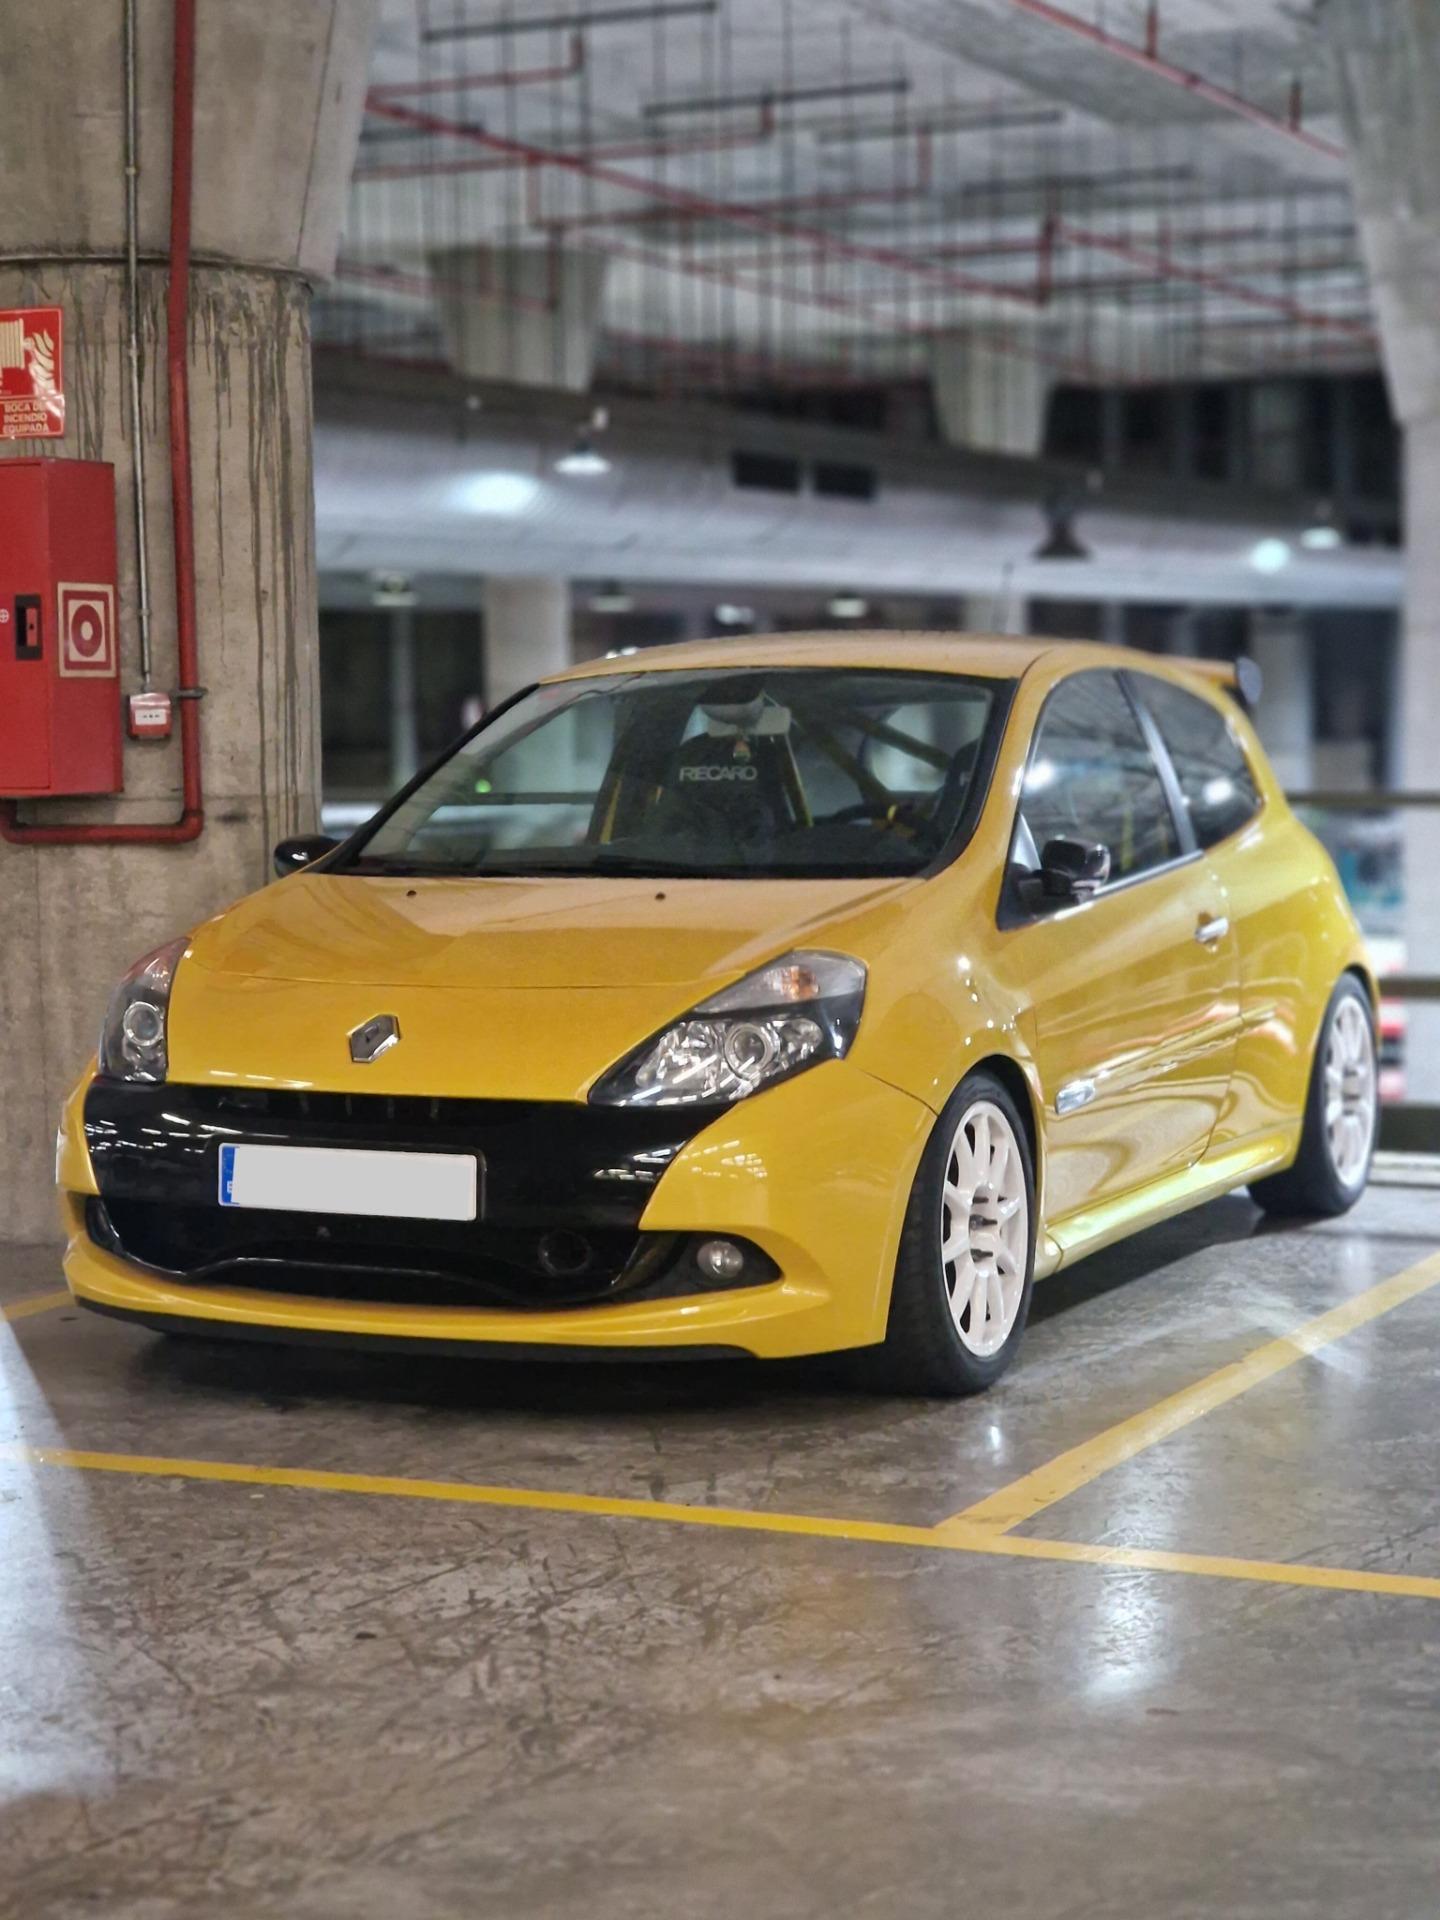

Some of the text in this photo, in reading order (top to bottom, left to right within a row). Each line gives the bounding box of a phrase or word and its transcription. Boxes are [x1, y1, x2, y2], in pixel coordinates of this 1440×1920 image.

[4, 401, 31, 412] BOCA
[4, 412, 48, 423] INCENDIO
[3, 423, 49, 434] EQUIPADA
[679, 766, 758, 781] RECARO
